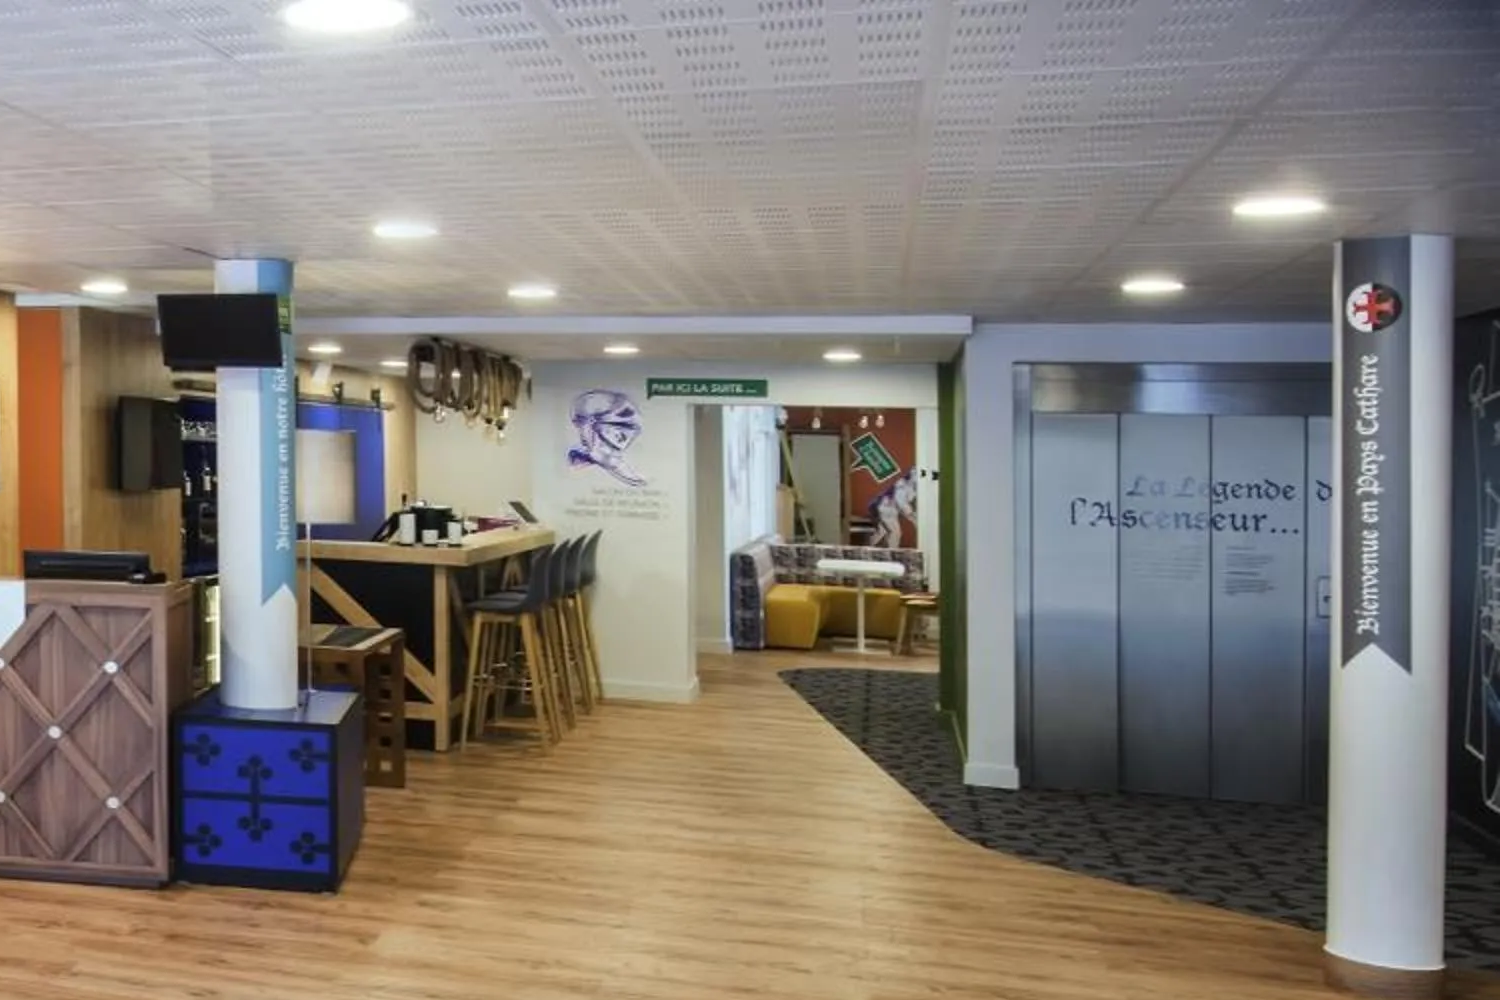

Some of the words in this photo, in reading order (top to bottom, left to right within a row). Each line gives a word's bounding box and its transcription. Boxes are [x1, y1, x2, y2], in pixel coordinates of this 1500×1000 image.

[1354, 354, 1384, 436] Cathare
[1125, 475, 1167, 498] La
[1356, 440, 1386, 495] Pays
[1361, 501, 1379, 523] en
[1355, 528, 1380, 635] Bienvenue
